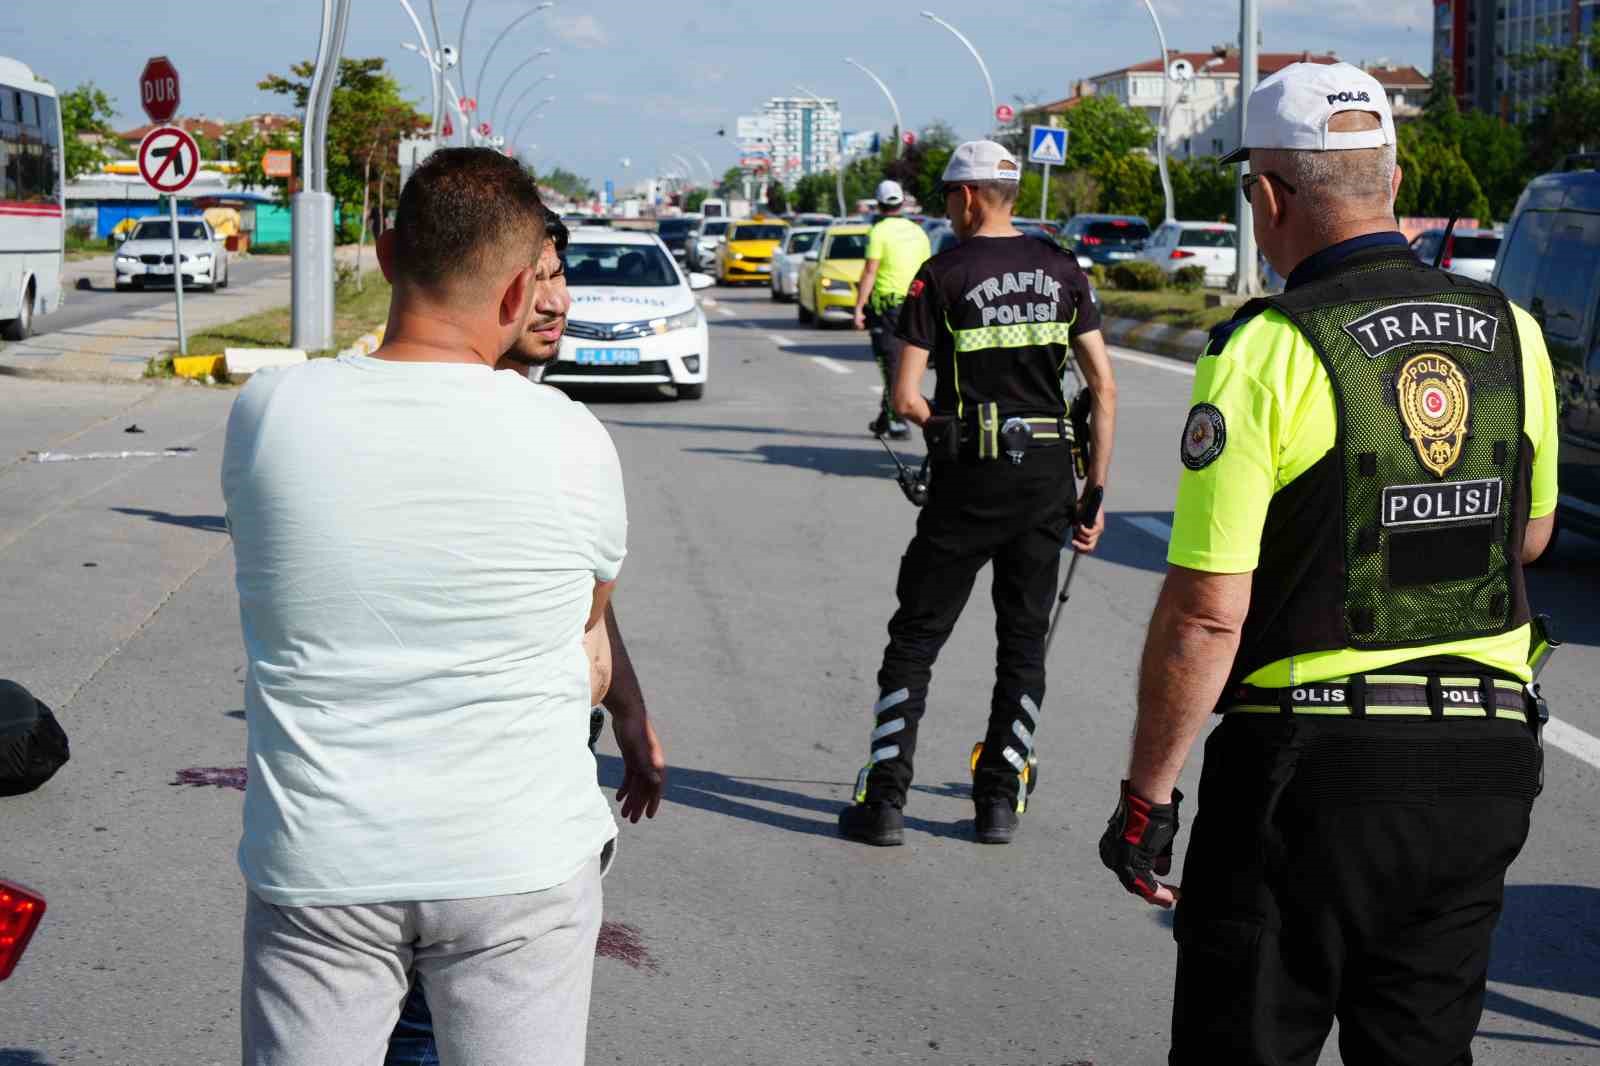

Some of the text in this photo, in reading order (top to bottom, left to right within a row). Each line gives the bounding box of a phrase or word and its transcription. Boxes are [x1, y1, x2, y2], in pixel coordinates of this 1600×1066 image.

[144, 77, 175, 103] DUR
[1357, 309, 1489, 348] TRAFİK
[1390, 482, 1492, 521] POLİSİ
